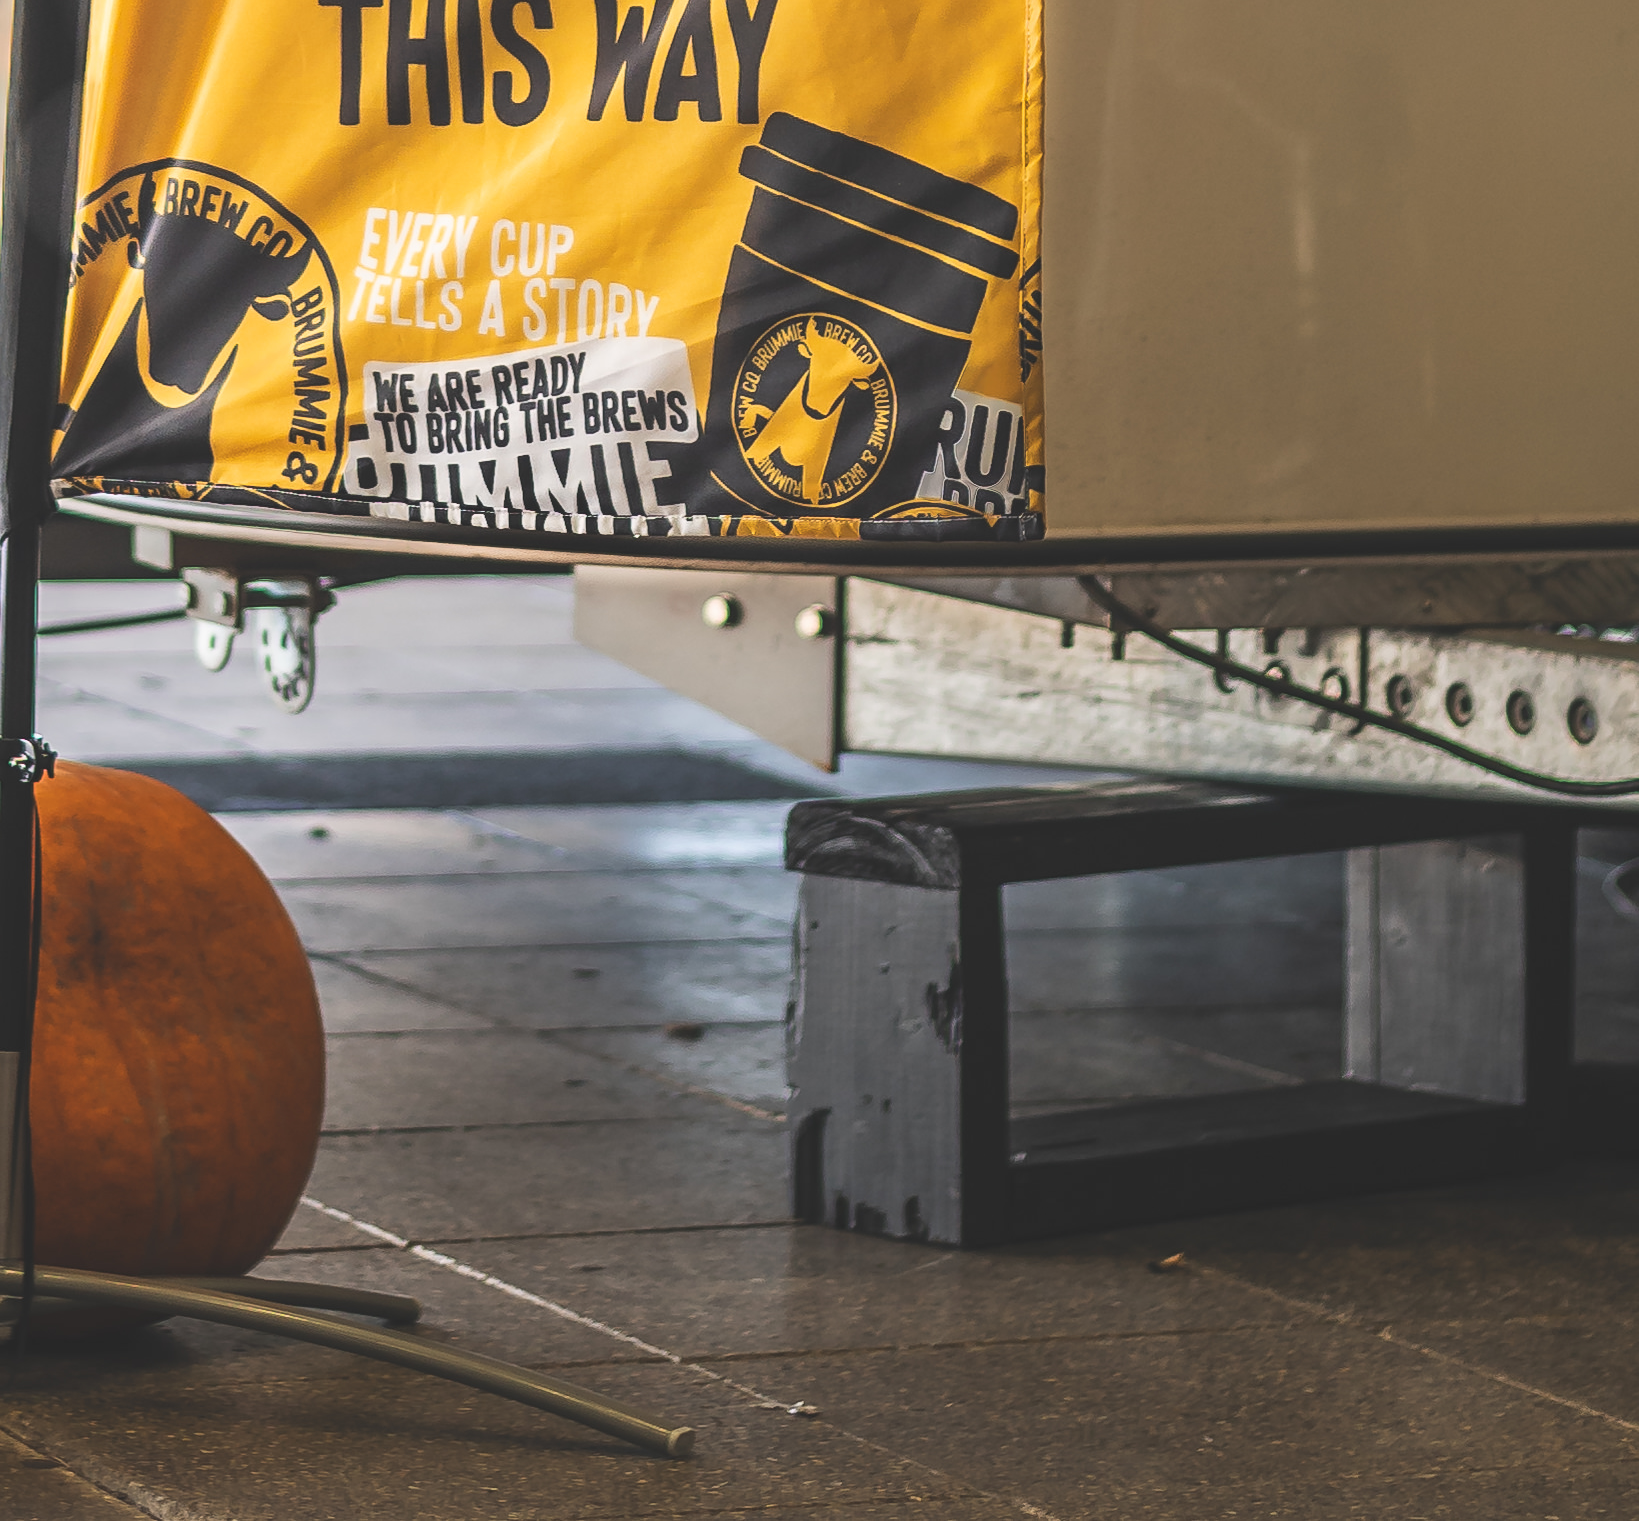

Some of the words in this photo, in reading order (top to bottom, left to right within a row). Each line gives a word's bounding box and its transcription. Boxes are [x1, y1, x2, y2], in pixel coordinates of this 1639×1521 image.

[164, 177, 249, 239] BREW
[358, 206, 479, 279] EVERY
[490, 218, 576, 276] CUP
[347, 266, 465, 333] TELLS
[478, 279, 506, 338] A
[521, 277, 661, 346] STORY
[287, 286, 331, 452] BRUMMIE
[751, 320, 806, 372] BRUMMIE
[372, 370, 420, 413] WE
[426, 368, 487, 413] ARE
[491, 351, 587, 407] READY
[372, 410, 418, 454] TO
[425, 405, 511, 455] BRING
[518, 395, 575, 444] THE
[581, 389, 690, 436] BREWS
[869, 377, 891, 452] BRUMMIE
[281, 450, 319, 486] &
[833, 461, 869, 498] BREW
[859, 448, 878, 467] &
